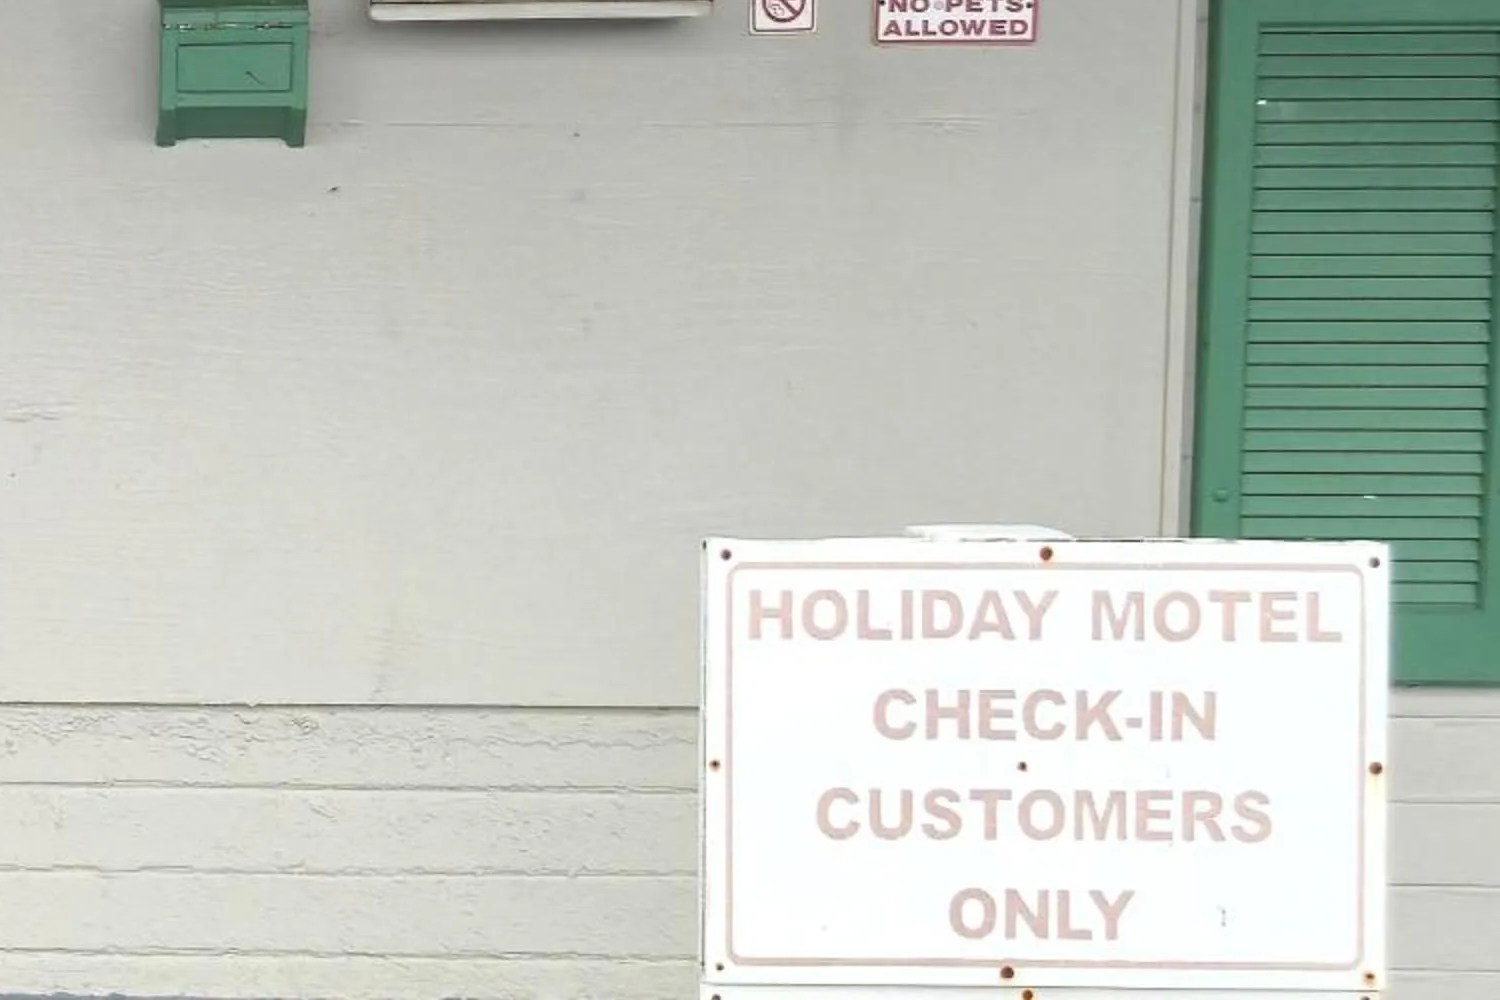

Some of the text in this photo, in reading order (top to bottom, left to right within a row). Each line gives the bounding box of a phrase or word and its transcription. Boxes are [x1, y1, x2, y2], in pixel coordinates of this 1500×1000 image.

[883, 19, 1030, 37] ALLOWED
[747, 588, 1343, 643] HOLIDAY MOTEL
[872, 688, 1218, 742] CHECK-IN
[816, 787, 1273, 843] CUSTOMERS
[948, 887, 1136, 941] ONLY
